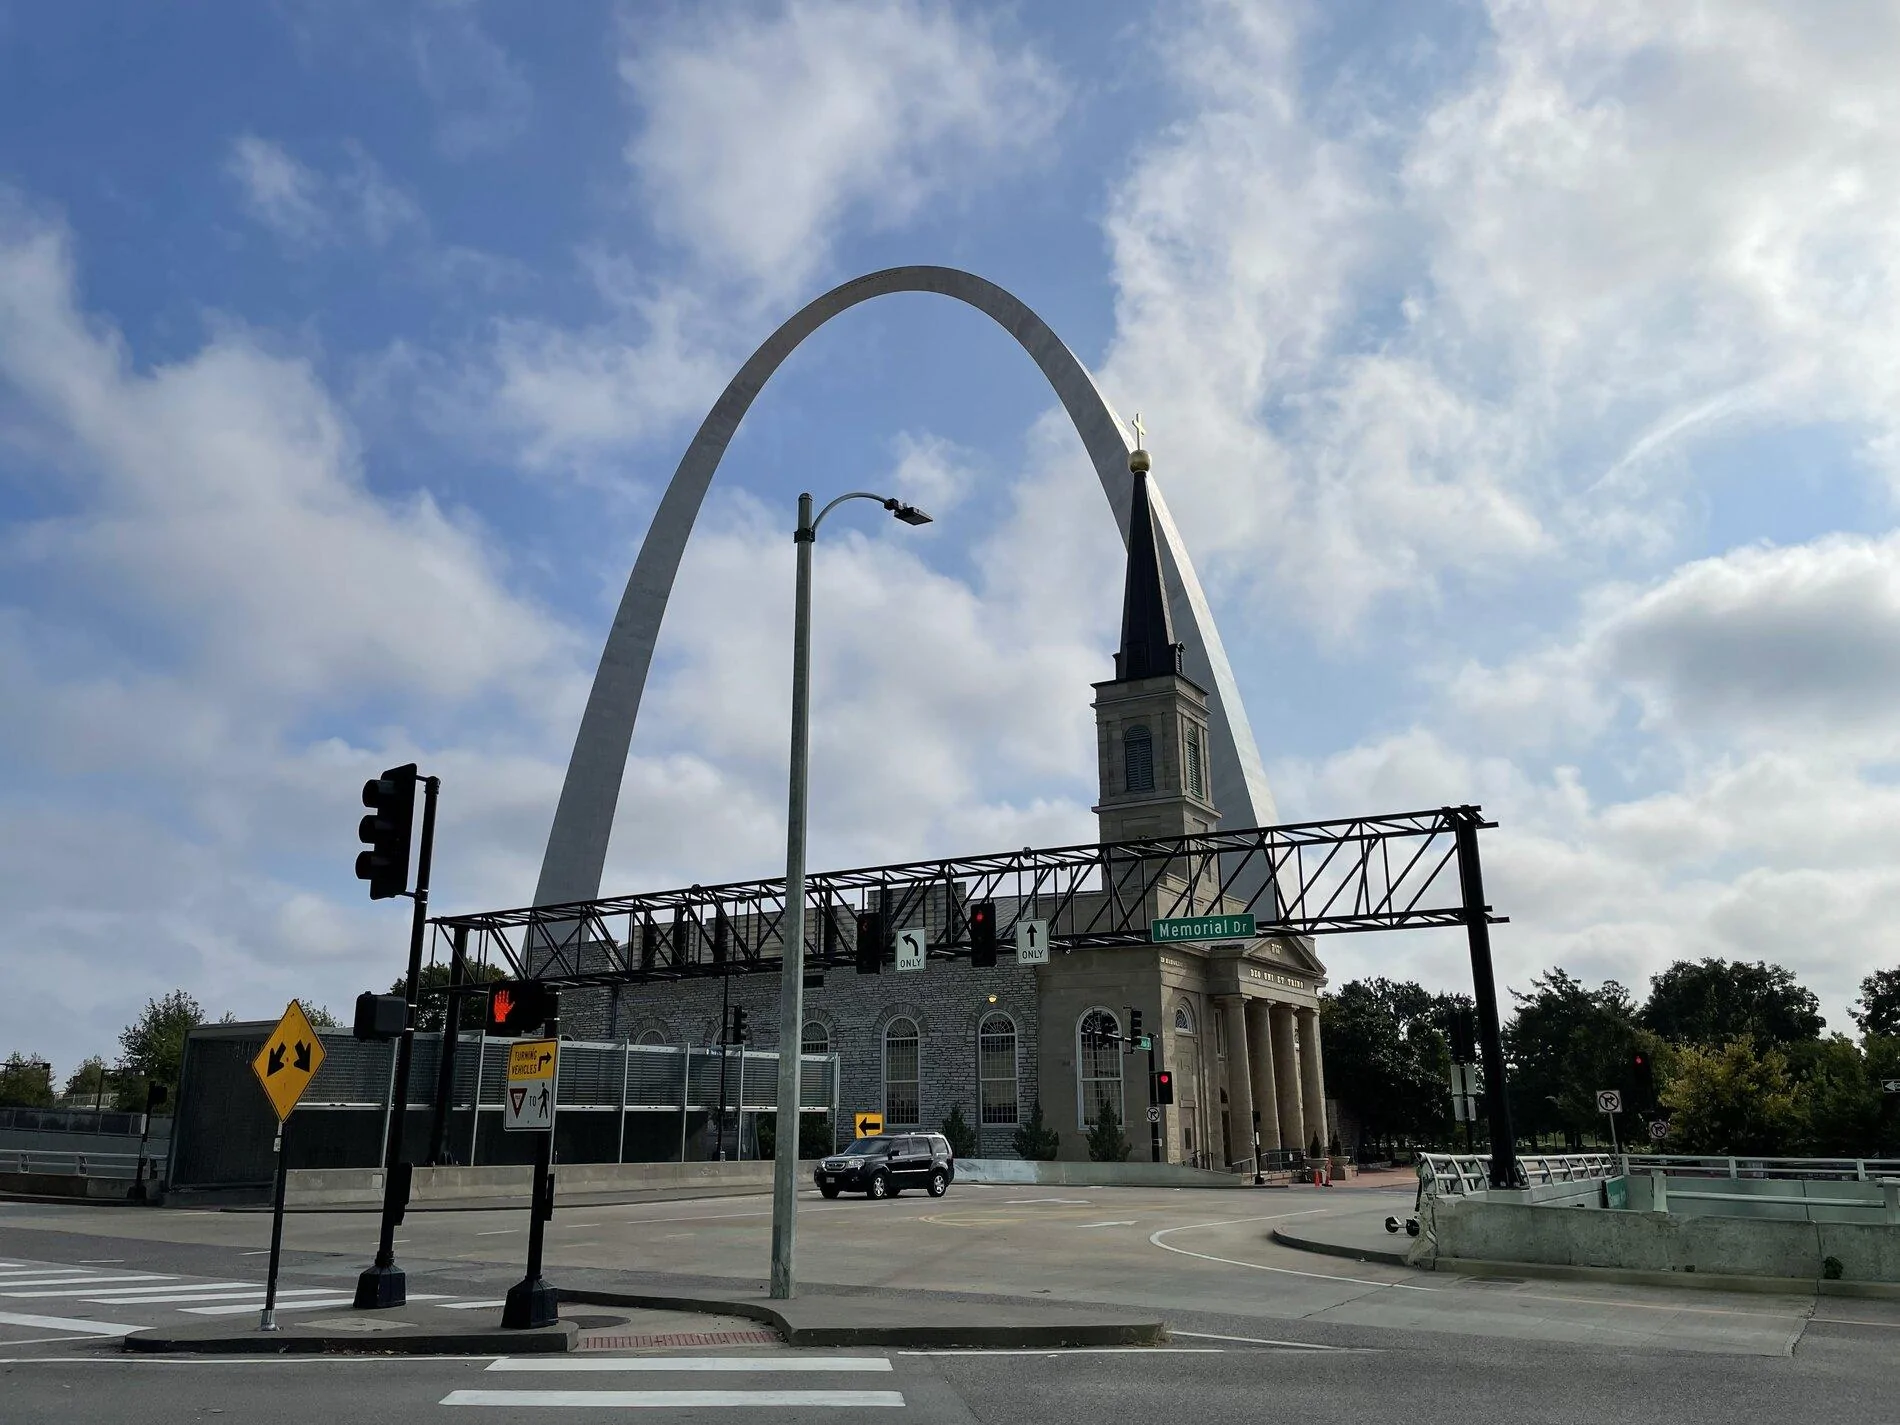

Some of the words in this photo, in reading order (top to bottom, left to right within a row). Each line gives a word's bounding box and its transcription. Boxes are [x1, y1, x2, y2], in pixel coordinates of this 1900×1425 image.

[1160, 919, 1228, 938] Memorial
[1233, 921, 1247, 933] Dr
[1022, 949, 1044, 960] ONLY
[900, 958, 922, 968] ONLY
[514, 1050, 538, 1062] TURNING
[511, 1064, 538, 1075] VEHICLES
[529, 1096, 537, 1107] TO
